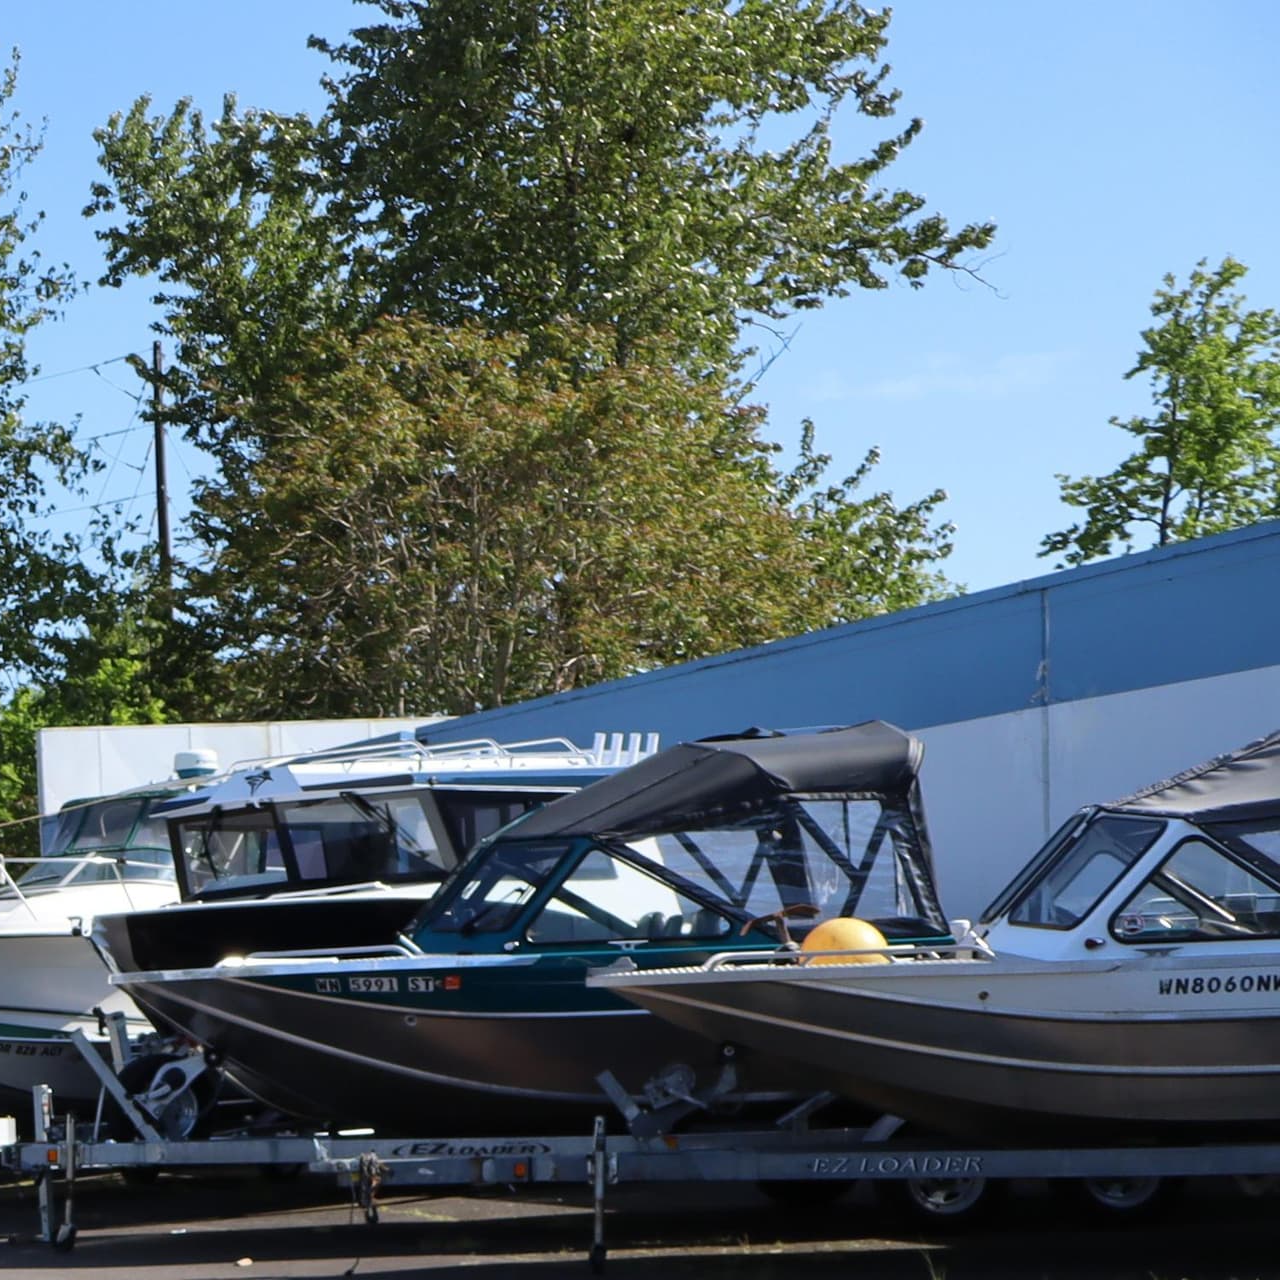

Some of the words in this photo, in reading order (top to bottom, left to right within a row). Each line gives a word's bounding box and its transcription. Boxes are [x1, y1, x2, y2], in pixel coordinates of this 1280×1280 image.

[351, 978, 395, 991] 5991
[410, 978, 432, 991] ST
[812, 1157, 849, 1174] EZ
[859, 1156, 982, 1174] LOADER
